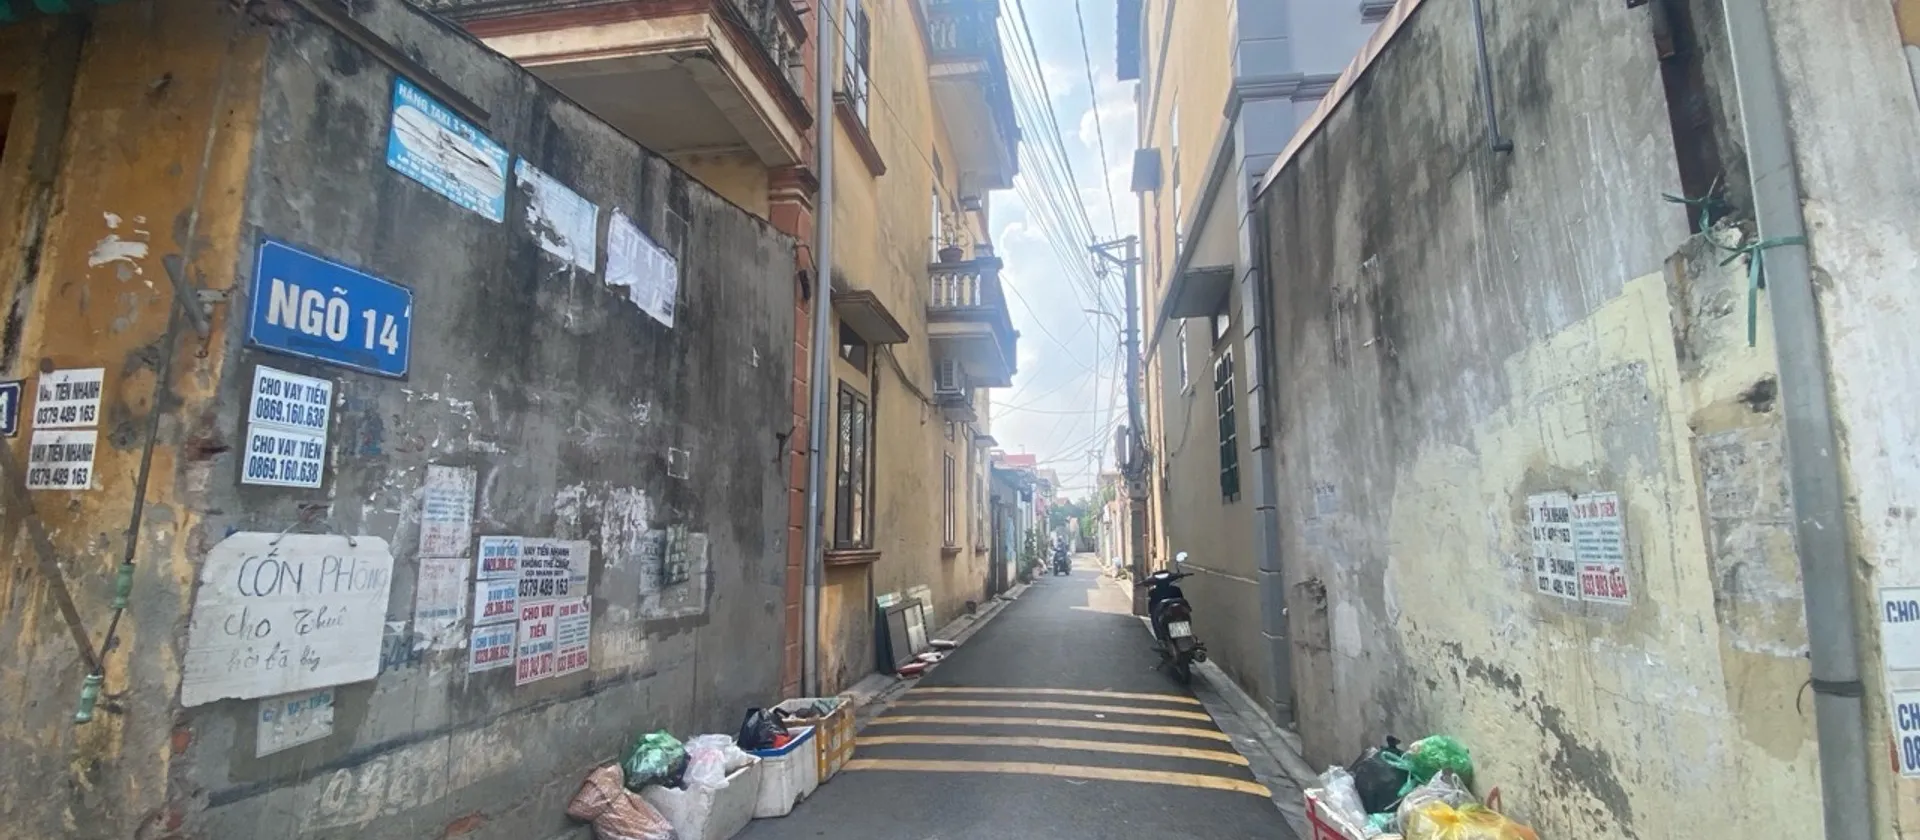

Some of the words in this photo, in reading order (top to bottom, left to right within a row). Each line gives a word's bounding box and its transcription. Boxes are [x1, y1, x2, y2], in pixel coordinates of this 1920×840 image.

[267, 277, 350, 342] NGÕ
[363, 308, 399, 355] 14
[72, 381, 101, 400] NHANH
[259, 376, 281, 397] CHO
[284, 381, 304, 400] VAY
[37, 406, 58, 424] 0379
[60, 405, 77, 422] 489
[80, 404, 95, 422] 163
[256, 397, 325, 428] 0869.160.638
[32, 444, 48, 462] VAY
[65, 443, 93, 462] NHANH
[252, 434, 275, 455] CHO
[278, 437, 297, 456] VAY
[29, 467, 51, 485] 0379
[52, 467, 69, 485] 489
[72, 467, 88, 485] 163
[248, 455, 319, 483] 0869.160.638
[555, 578, 568, 596] 163
[522, 606, 540, 621] CHO
[541, 604, 555, 618] VAY
